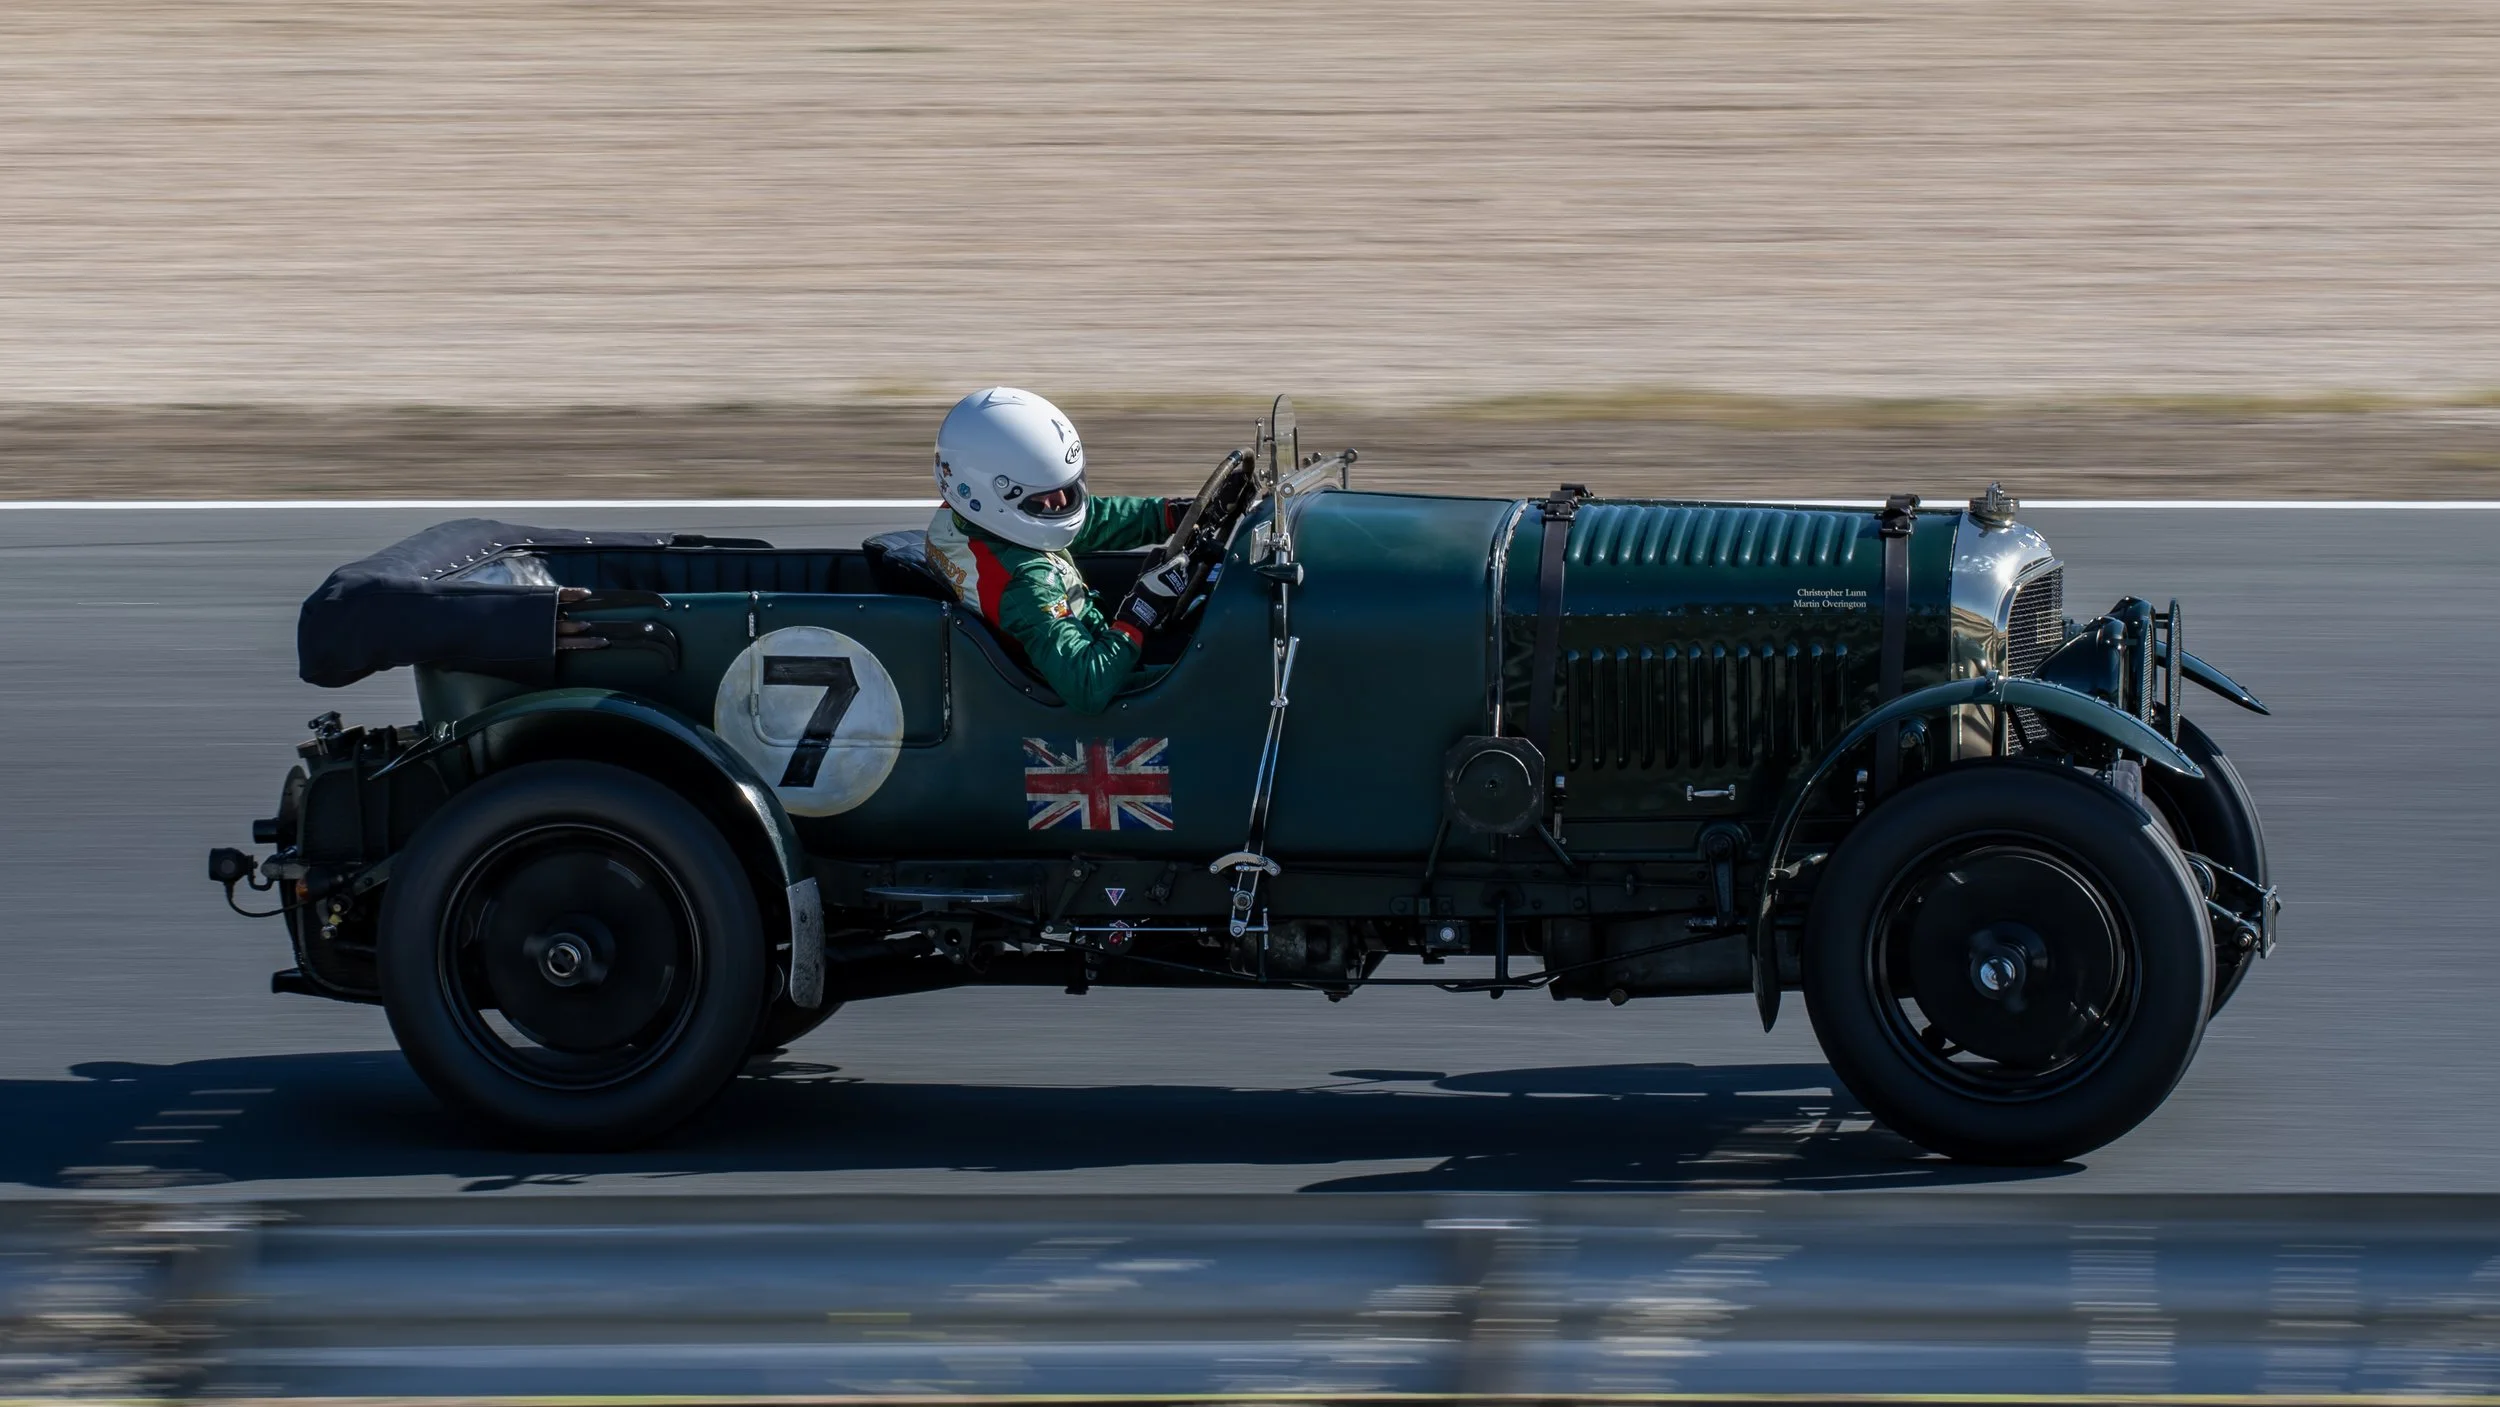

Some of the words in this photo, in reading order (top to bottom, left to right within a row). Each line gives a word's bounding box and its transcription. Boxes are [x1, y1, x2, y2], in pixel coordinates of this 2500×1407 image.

[1797, 588, 1843, 599] Christopher
[1845, 588, 1867, 597] Lunn
[1793, 599, 1820, 608] Martin
[1821, 599, 1867, 610] Overington
[763, 656, 860, 788] 7
